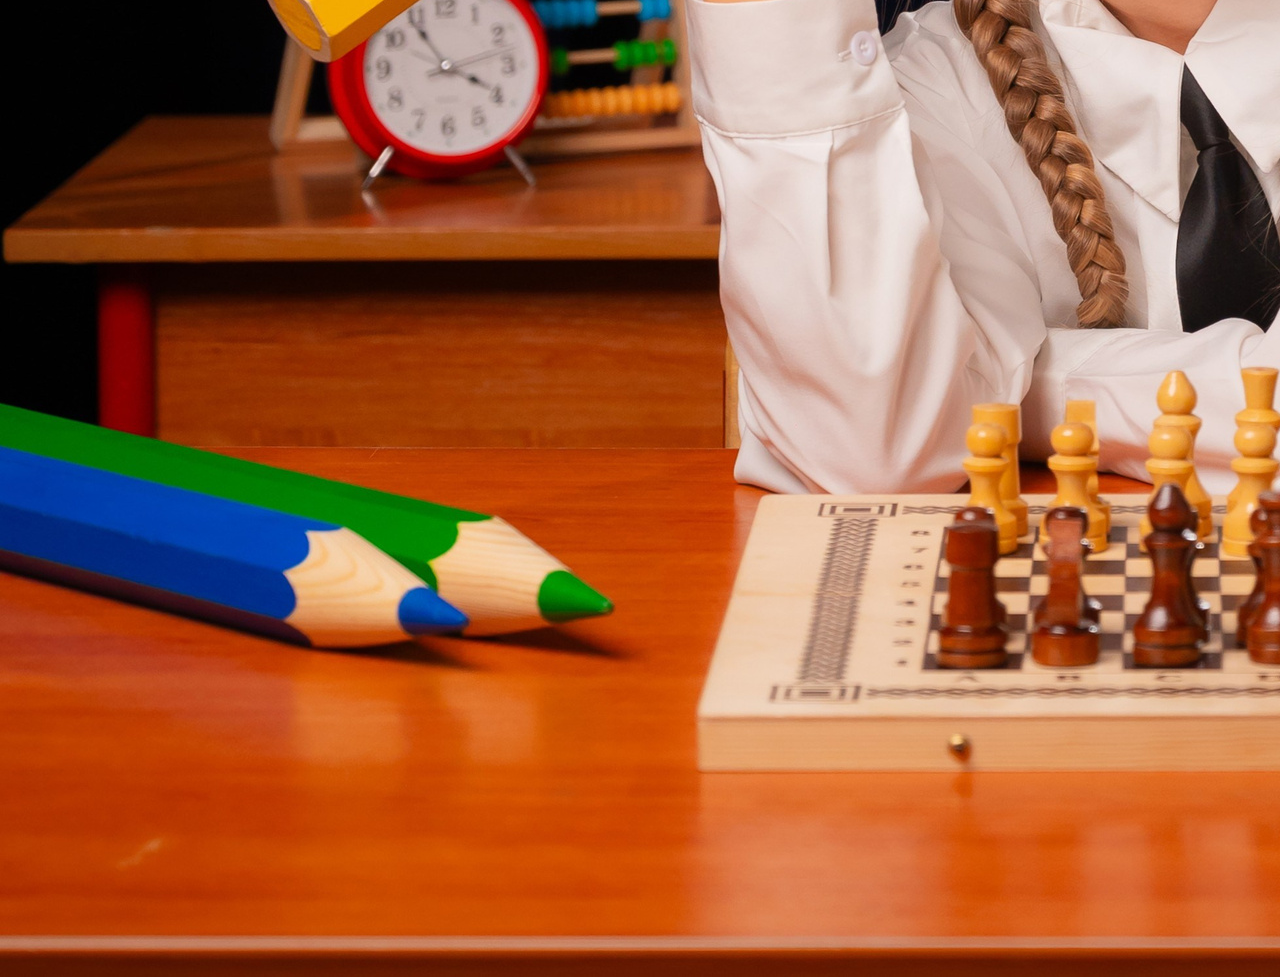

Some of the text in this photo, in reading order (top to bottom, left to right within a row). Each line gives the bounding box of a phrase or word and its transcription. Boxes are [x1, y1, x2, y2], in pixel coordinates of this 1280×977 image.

[470, 3, 480, 25] 1
[385, 27, 406, 51] 10
[491, 21, 505, 45] 2
[376, 56, 392, 83] 9
[501, 53, 516, 76] 3
[387, 85, 403, 111] 8
[411, 108, 426, 131] 7
[440, 114, 456, 138] 6
[471, 105, 488, 127] 5
